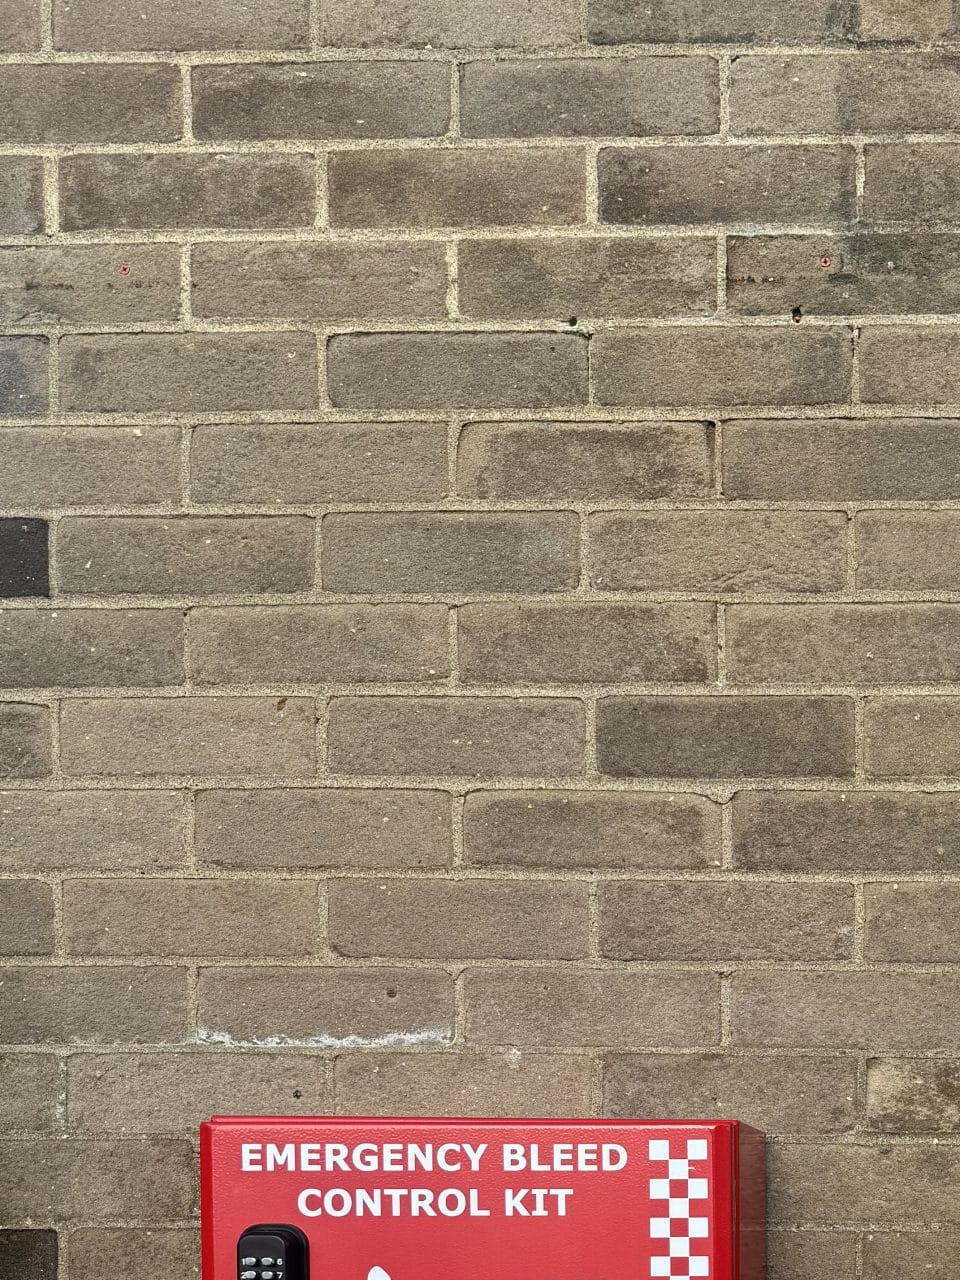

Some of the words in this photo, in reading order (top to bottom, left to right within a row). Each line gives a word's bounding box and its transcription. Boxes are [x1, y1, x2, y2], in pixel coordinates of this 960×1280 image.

[242, 1143, 488, 1171] EMERGENCY
[503, 1144, 627, 1171] BLEED
[298, 1189, 490, 1217] CONTROL
[505, 1189, 573, 1216] KIT
[276, 1258, 284, 1266] 6
[276, 1271, 284, 1280] 7
